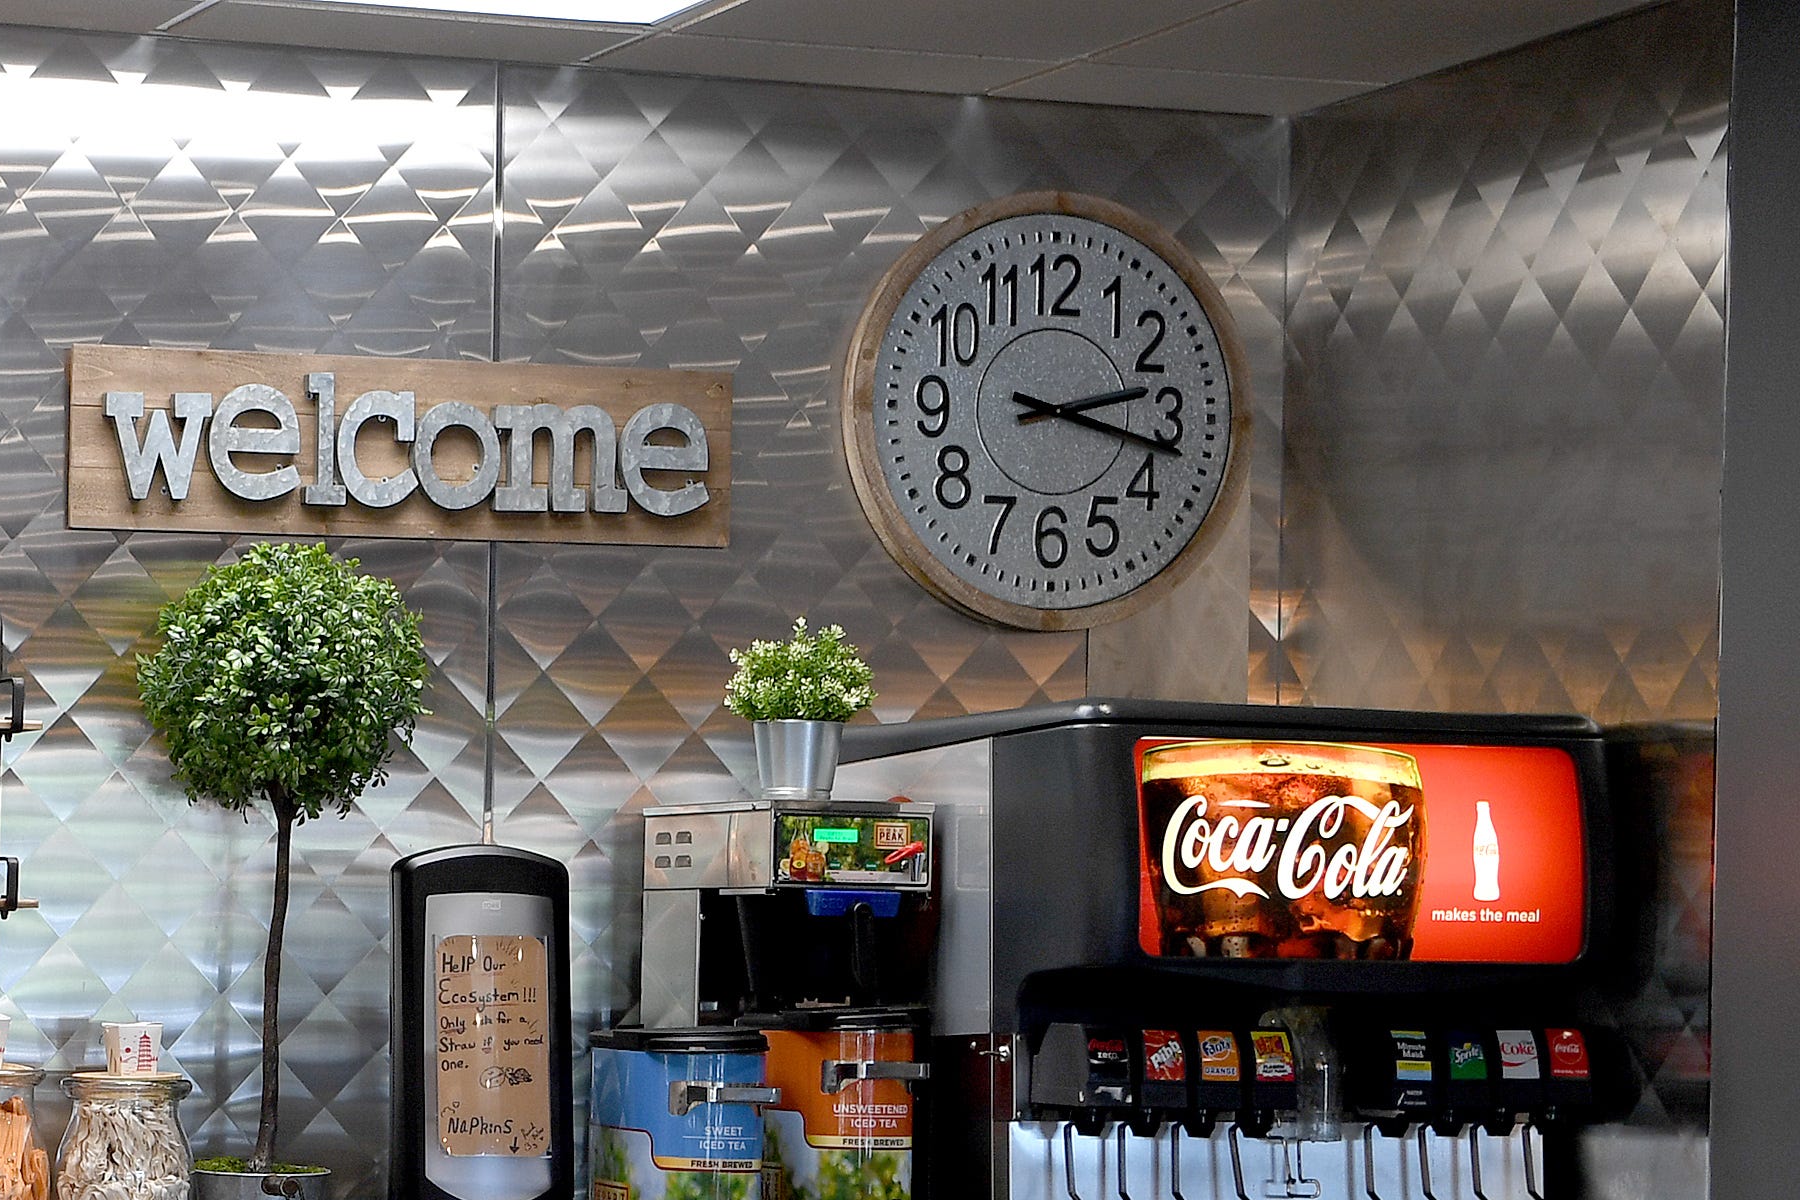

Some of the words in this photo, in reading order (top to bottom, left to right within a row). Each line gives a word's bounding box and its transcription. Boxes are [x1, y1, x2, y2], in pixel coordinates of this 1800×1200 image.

[980, 263, 1019, 326] 11
[1028, 253, 1082, 317] 12
[1101, 276, 1122, 339] 1
[930, 302, 980, 367] 10
[1135, 310, 1166, 373] 2
[914, 375, 950, 438] 9
[1153, 386, 1184, 448] 3
[103, 372, 710, 517] welcome
[933, 445, 972, 510] 8
[1125, 453, 1160, 511] 4
[983, 495, 1017, 555] 7
[1034, 506, 1068, 569] 6
[1085, 496, 1121, 558] 5
[879, 832, 904, 841] PEAK
[1162, 794, 1415, 900] Coca-Cola
[1431, 908, 1476, 923] makes
[1479, 908, 1503, 923] the
[1506, 908, 1540, 923] meal
[440, 1016, 466, 1034] Only
[496, 1011, 512, 1024] for
[483, 1036, 493, 1047] if
[503, 1038, 520, 1051] you
[524, 1034, 544, 1045] need
[1150, 1040, 1181, 1070] Pibb
[1202, 1040, 1231, 1056] Fanta
[1397, 1042, 1426, 1051] Minute
[1402, 1050, 1424, 1058] Maid
[1455, 1046, 1481, 1063] Sprite
[1501, 1042, 1534, 1056] Coke
[1205, 1066, 1236, 1075] ORANGE
[833, 1104, 908, 1115] UNSWEETENED
[705, 1126, 743, 1137] SWEET
[851, 1118, 875, 1128] ICED
[879, 1118, 898, 1128] TEA
[700, 1140, 724, 1150] ICED
[729, 1141, 746, 1150] TEA
[690, 1160, 719, 1168] FRESH
[722, 1160, 753, 1169] BREWED
